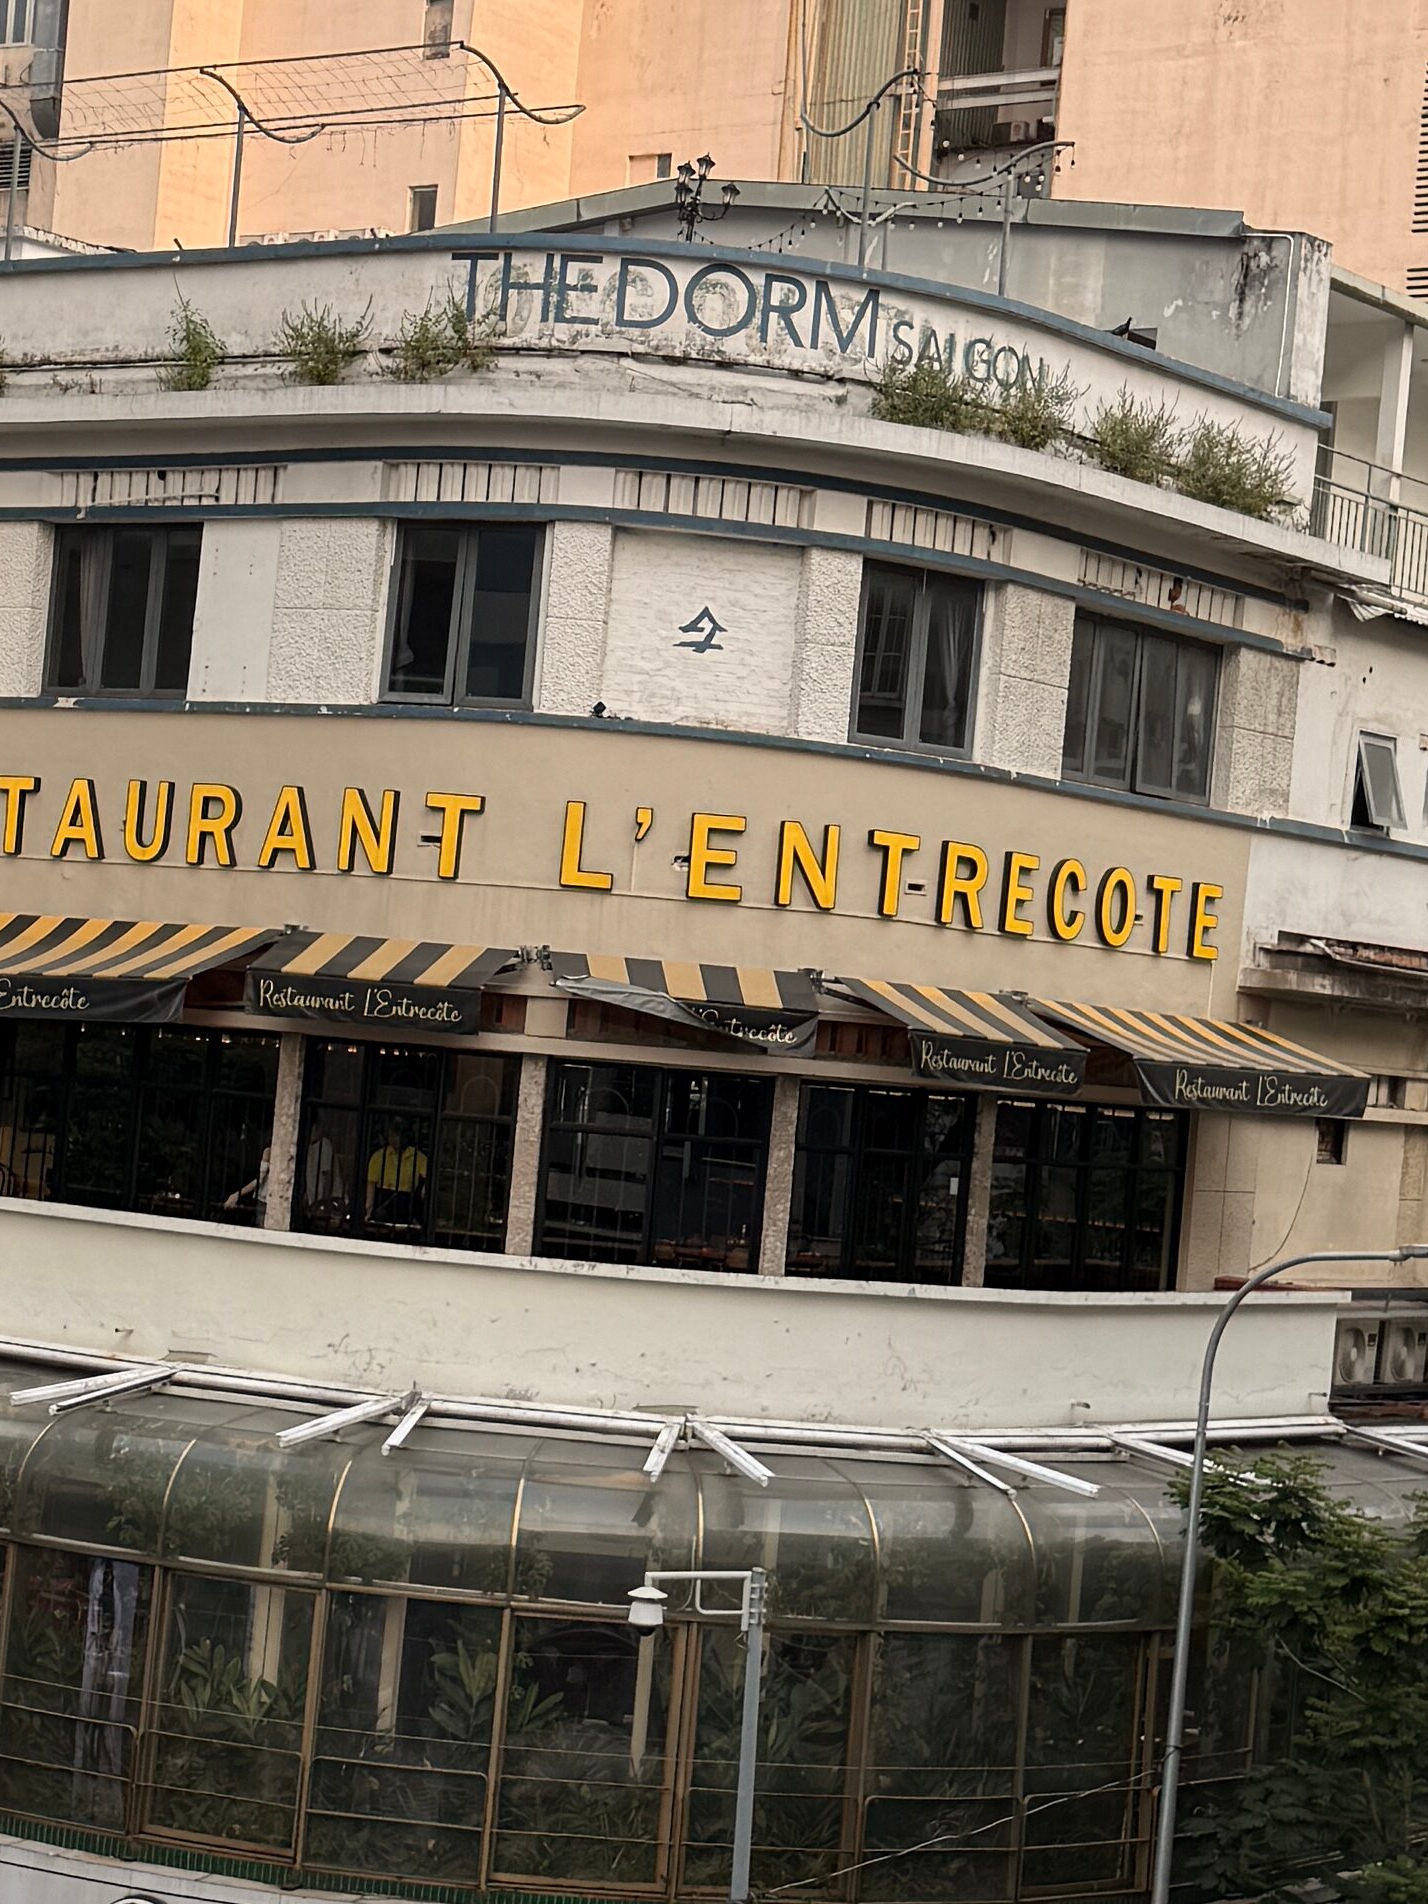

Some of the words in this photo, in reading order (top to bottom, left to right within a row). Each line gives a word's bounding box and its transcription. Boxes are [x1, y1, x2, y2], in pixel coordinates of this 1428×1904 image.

[451, 251, 605, 328] THE
[615, 256, 880, 359] DORM
[891, 319, 1051, 393] SAIGON
[559, 800, 1226, 962] L'ENTRECOTE
[259, 978, 356, 1012] Restaurant
[363, 988, 463, 1022] L'Entrecôte
[921, 1040, 998, 1074] Restaurant
[1175, 1068, 1251, 1101] Restaurant
